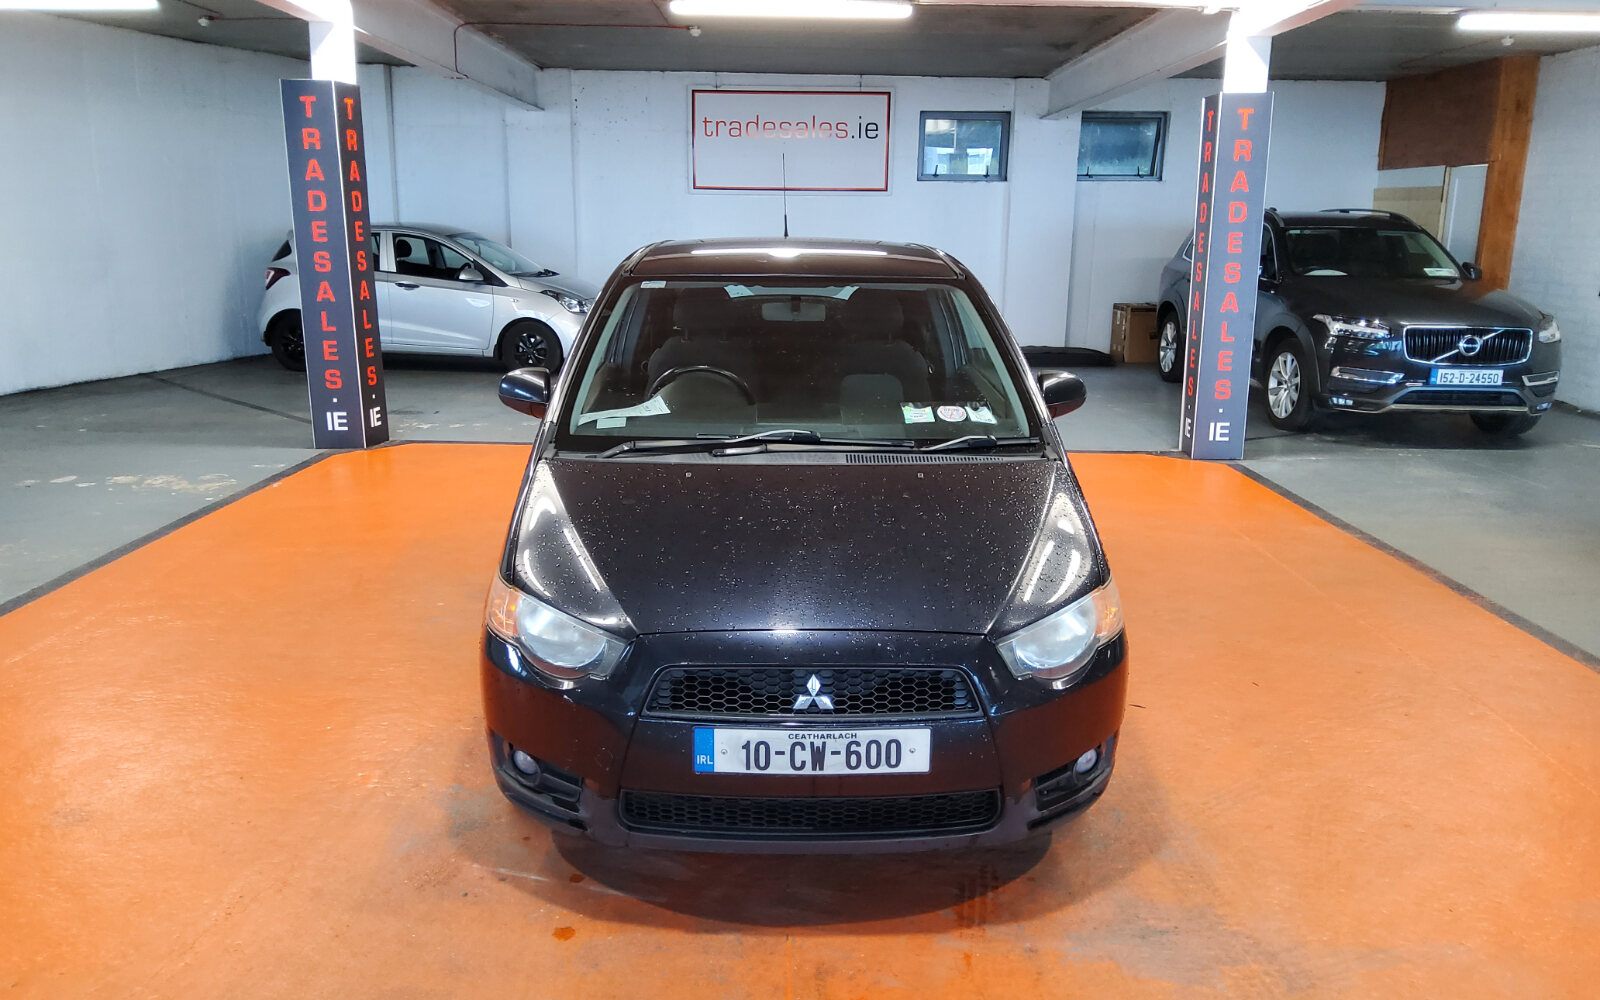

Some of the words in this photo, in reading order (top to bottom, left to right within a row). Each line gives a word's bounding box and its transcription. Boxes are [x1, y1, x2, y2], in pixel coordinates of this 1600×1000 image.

[702, 114, 878, 139] tradesales.ie
[1440, 373, 1499, 384] 152-D-24550
[788, 732, 857, 740] CEATHARLACH
[696, 754, 713, 765] IRL
[741, 738, 902, 771] 10-CW-600
